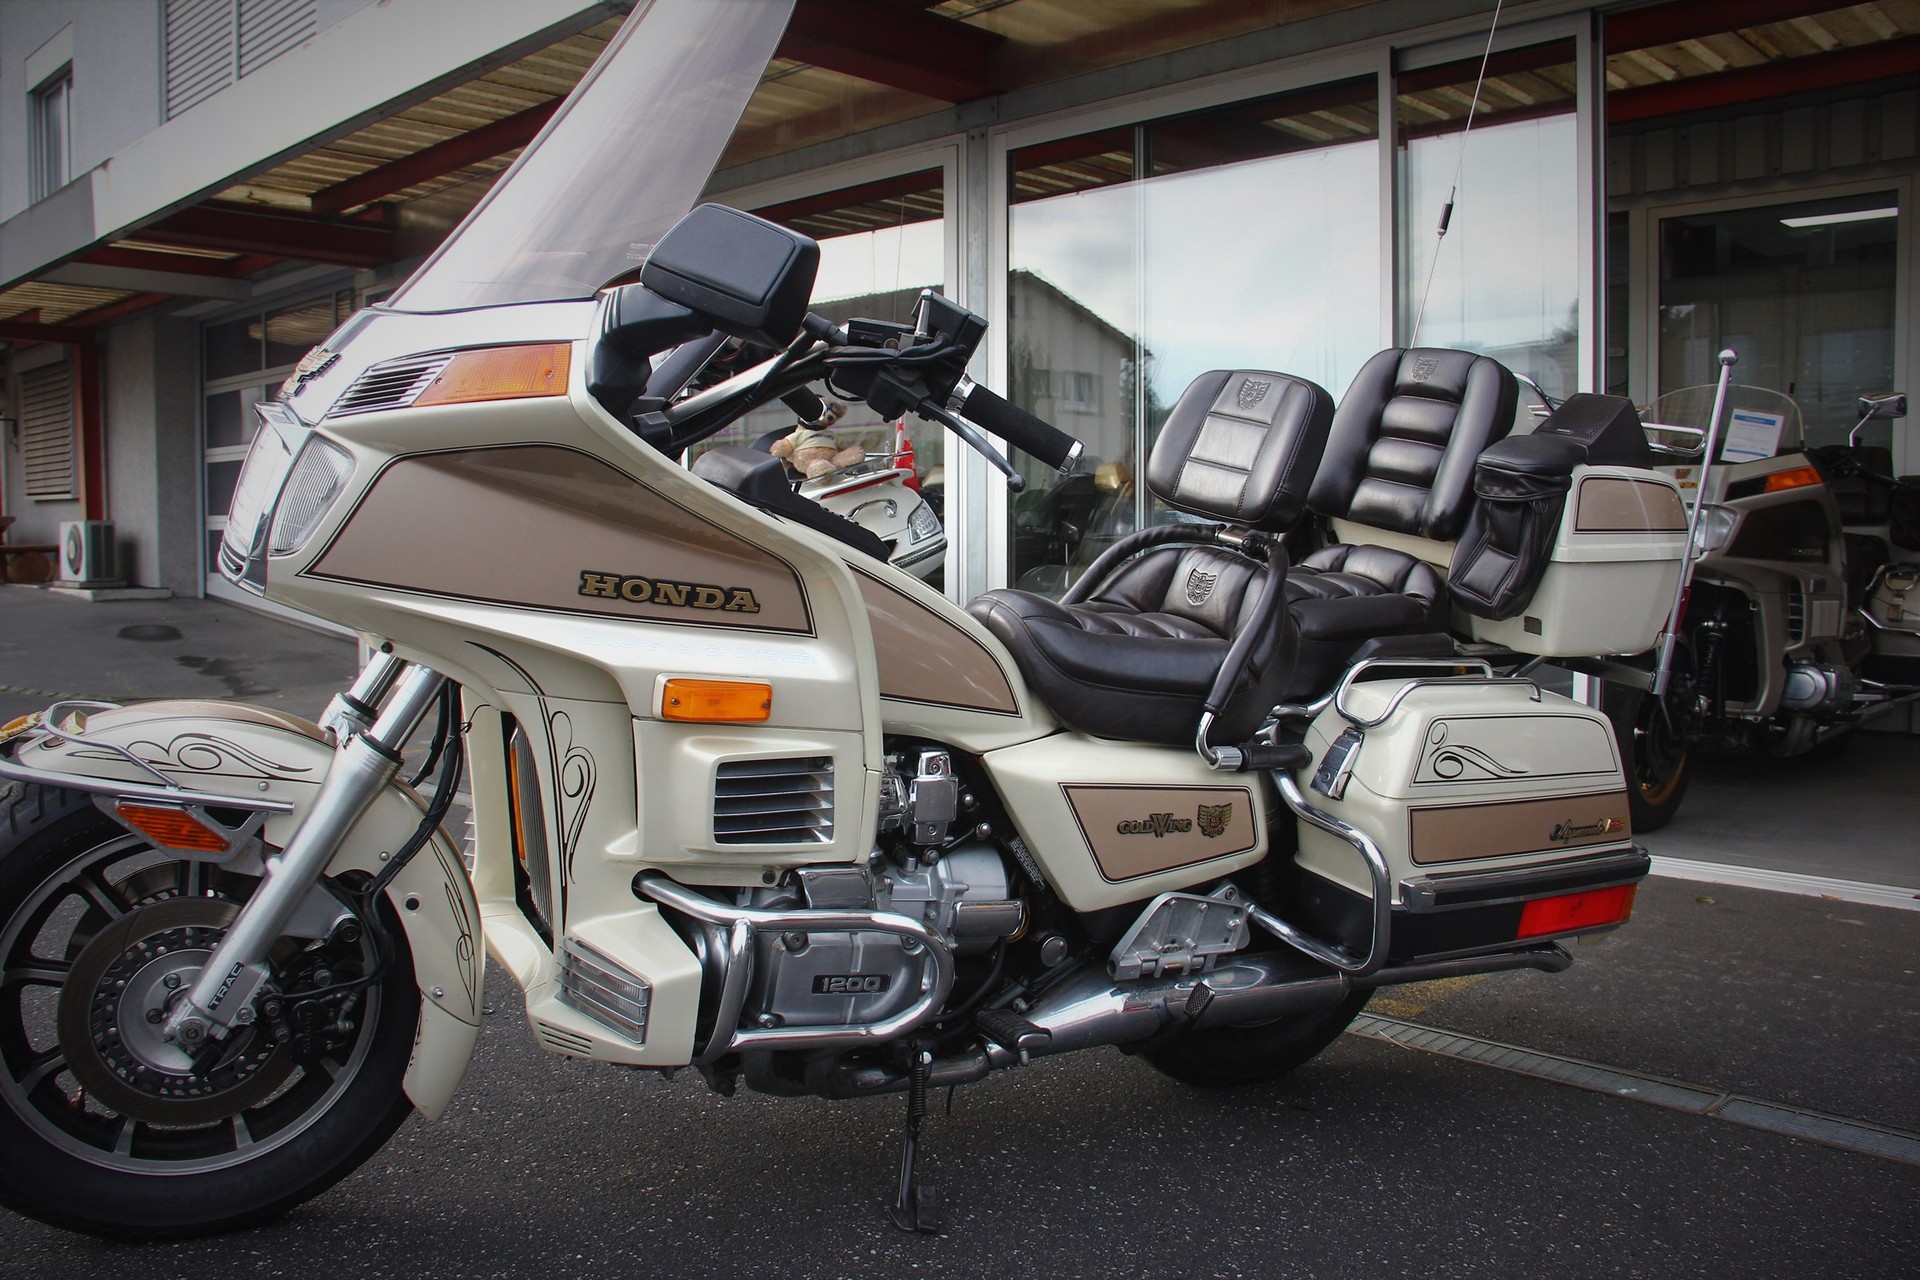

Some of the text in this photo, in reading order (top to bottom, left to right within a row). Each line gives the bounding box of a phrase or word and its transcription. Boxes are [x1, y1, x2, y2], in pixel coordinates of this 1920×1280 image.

[580, 571, 760, 613] HONDA
[209, 963, 243, 1007] TRAC
[822, 977, 881, 992] 1200
